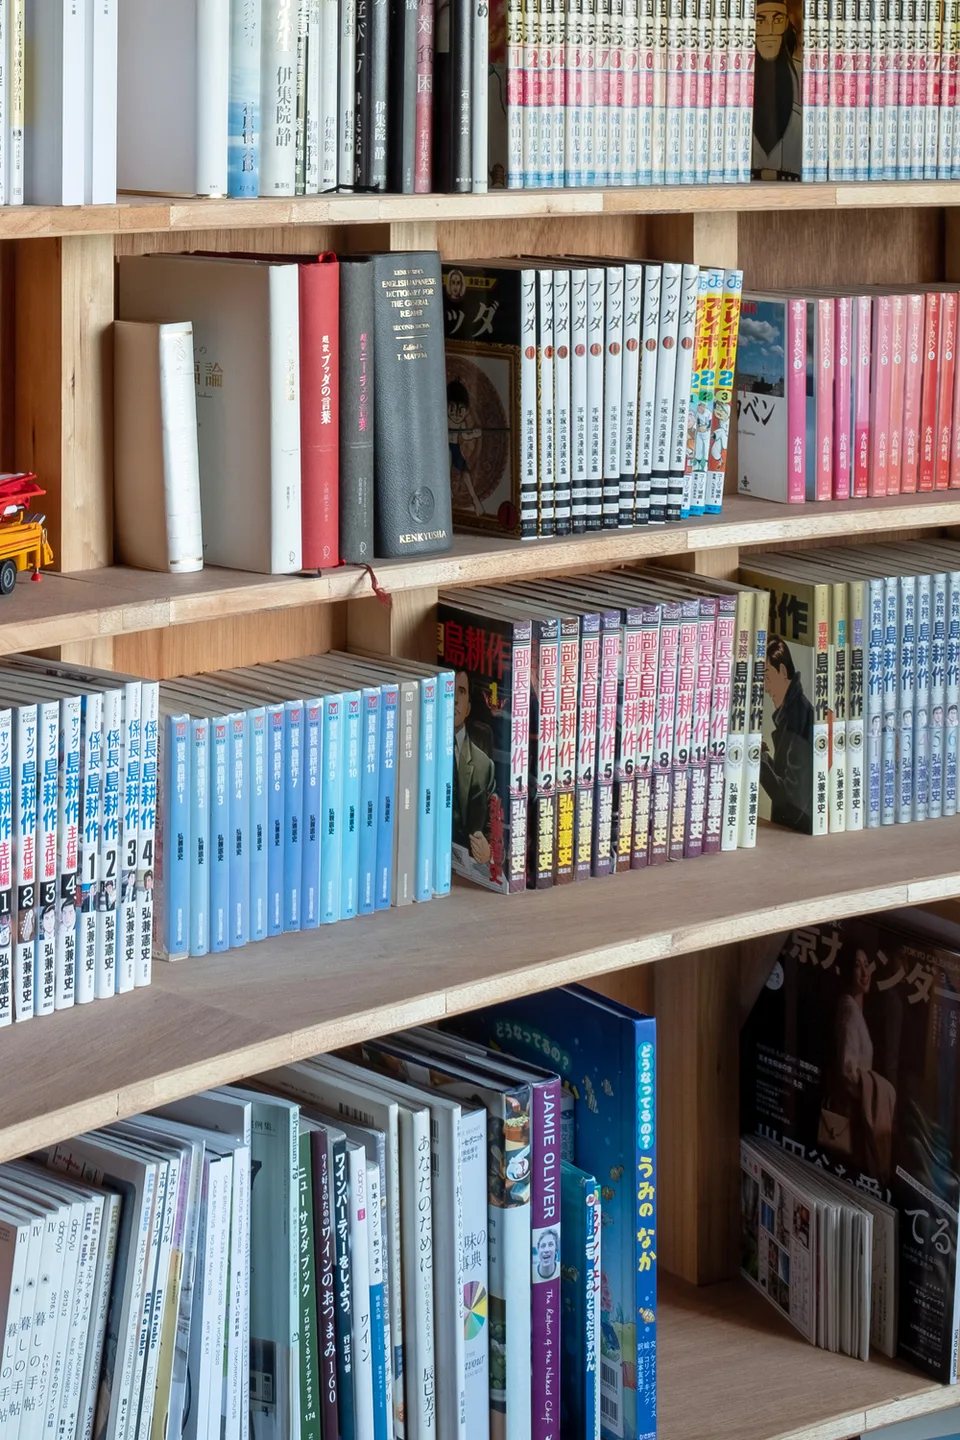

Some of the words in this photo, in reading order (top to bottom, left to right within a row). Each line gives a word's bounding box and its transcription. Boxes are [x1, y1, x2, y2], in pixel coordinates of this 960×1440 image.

[523, 280, 536, 334] ブッダ
[664, 275, 679, 325] ブッダ
[719, 298, 741, 370] プレイボール
[718, 370, 733, 387] 2
[526, 409, 534, 476] 手塚治虫漫画全集
[399, 530, 447, 544] KENKYUSHA
[818, 622, 828, 650] 専務
[511, 648, 530, 775] 部長島耕作
[0, 732, 10, 765] ヤング
[712, 741, 726, 757] 12
[819, 738, 825, 749] 3
[903, 734, 911, 752] 3
[515, 776, 524, 792] 1
[563, 770, 572, 786] 3
[817, 771, 826, 814] 弘兼憲史
[511, 800, 526, 873] 弘兼憲史
[0, 893, 9, 912] 1
[85, 917, 94, 971] 弘兼憲史
[543, 1091, 555, 1146] JAMIE
[321, 1153, 329, 1225] ワイン好きのための
[417, 1134, 433, 1271] あなたのために
[543, 1153, 555, 1219] OLIVER
[636, 1155, 654, 1219] うみの
[298, 1168, 311, 1297] ニューサラダブック
[370, 1183, 380, 1275] 日本ワインと和つまみ
[636, 1225, 657, 1272] なか
[905, 1208, 952, 1255] てる
[321, 1226, 337, 1403] ワインのおつまみ160
[304, 1308, 313, 1410] プロがつくるアイデアサラダ
[305, 1412, 316, 1421] 174
[422, 1365, 434, 1428] 辰巳芳子
